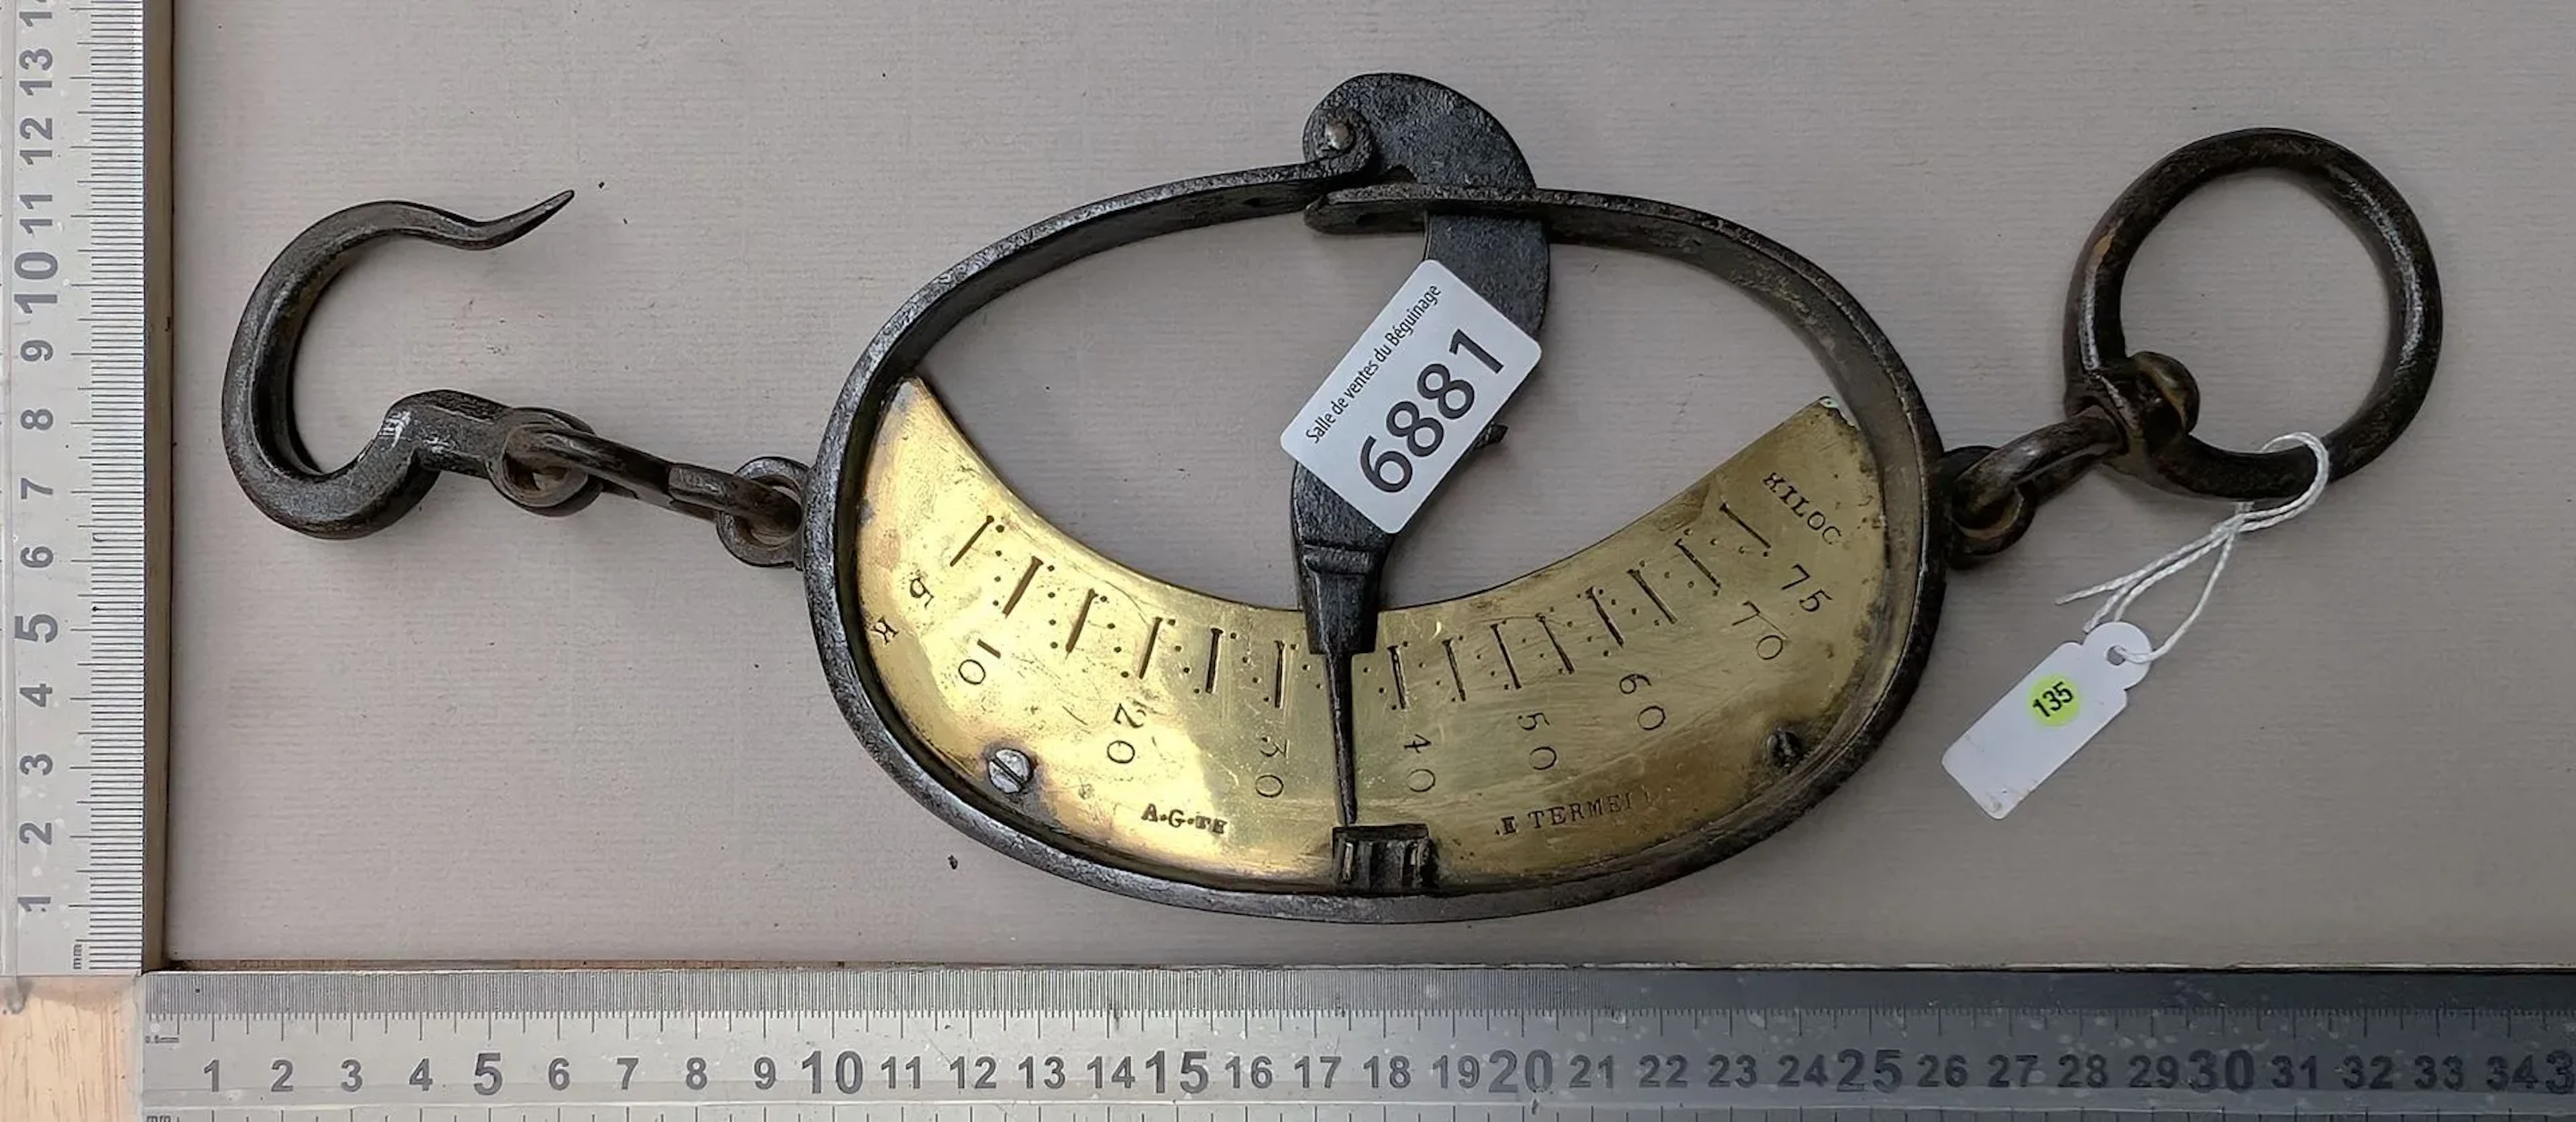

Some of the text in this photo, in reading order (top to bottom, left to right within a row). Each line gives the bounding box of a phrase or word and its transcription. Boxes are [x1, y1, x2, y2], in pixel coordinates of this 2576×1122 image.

[19, 0, 52, 27] 1
[19, 49, 52, 95] 13
[20, 118, 52, 164] 12
[19, 195, 52, 234] 11
[14, 252, 58, 313] 10
[21, 340, 53, 361] 9
[1306, 284, 1442, 444] Salle de ventes du Béguinage
[21, 409, 53, 430] 8
[1359, 328, 1504, 493] 6881
[21, 478, 53, 499] 7
[21, 547, 53, 568] 6
[1781, 564, 1833, 615] 75
[15, 615, 58, 643] 5
[1732, 601, 1784, 662] 70
[958, 639, 1002, 686] 10
[20, 684, 52, 707] 4
[1619, 672, 1667, 731] 60
[2032, 681, 2074, 717] 135
[1106, 701, 1146, 764] 20
[1516, 711, 1558, 771] 50
[20, 754, 52, 775] 3
[1255, 737, 1288, 798] 30
[1404, 733, 1436, 793] 40
[19, 823, 52, 845] 2
[17, 897, 51, 912] 1
[74, 944, 82, 969] mm
[204, 1050, 2575, 1095] 1 2 3 4 5 6 7 8 9 10 11 12 13 14 15 16 17 18 19 20 21 22 23 24 25 26 27 28 29 30 31 32 33 34 3
